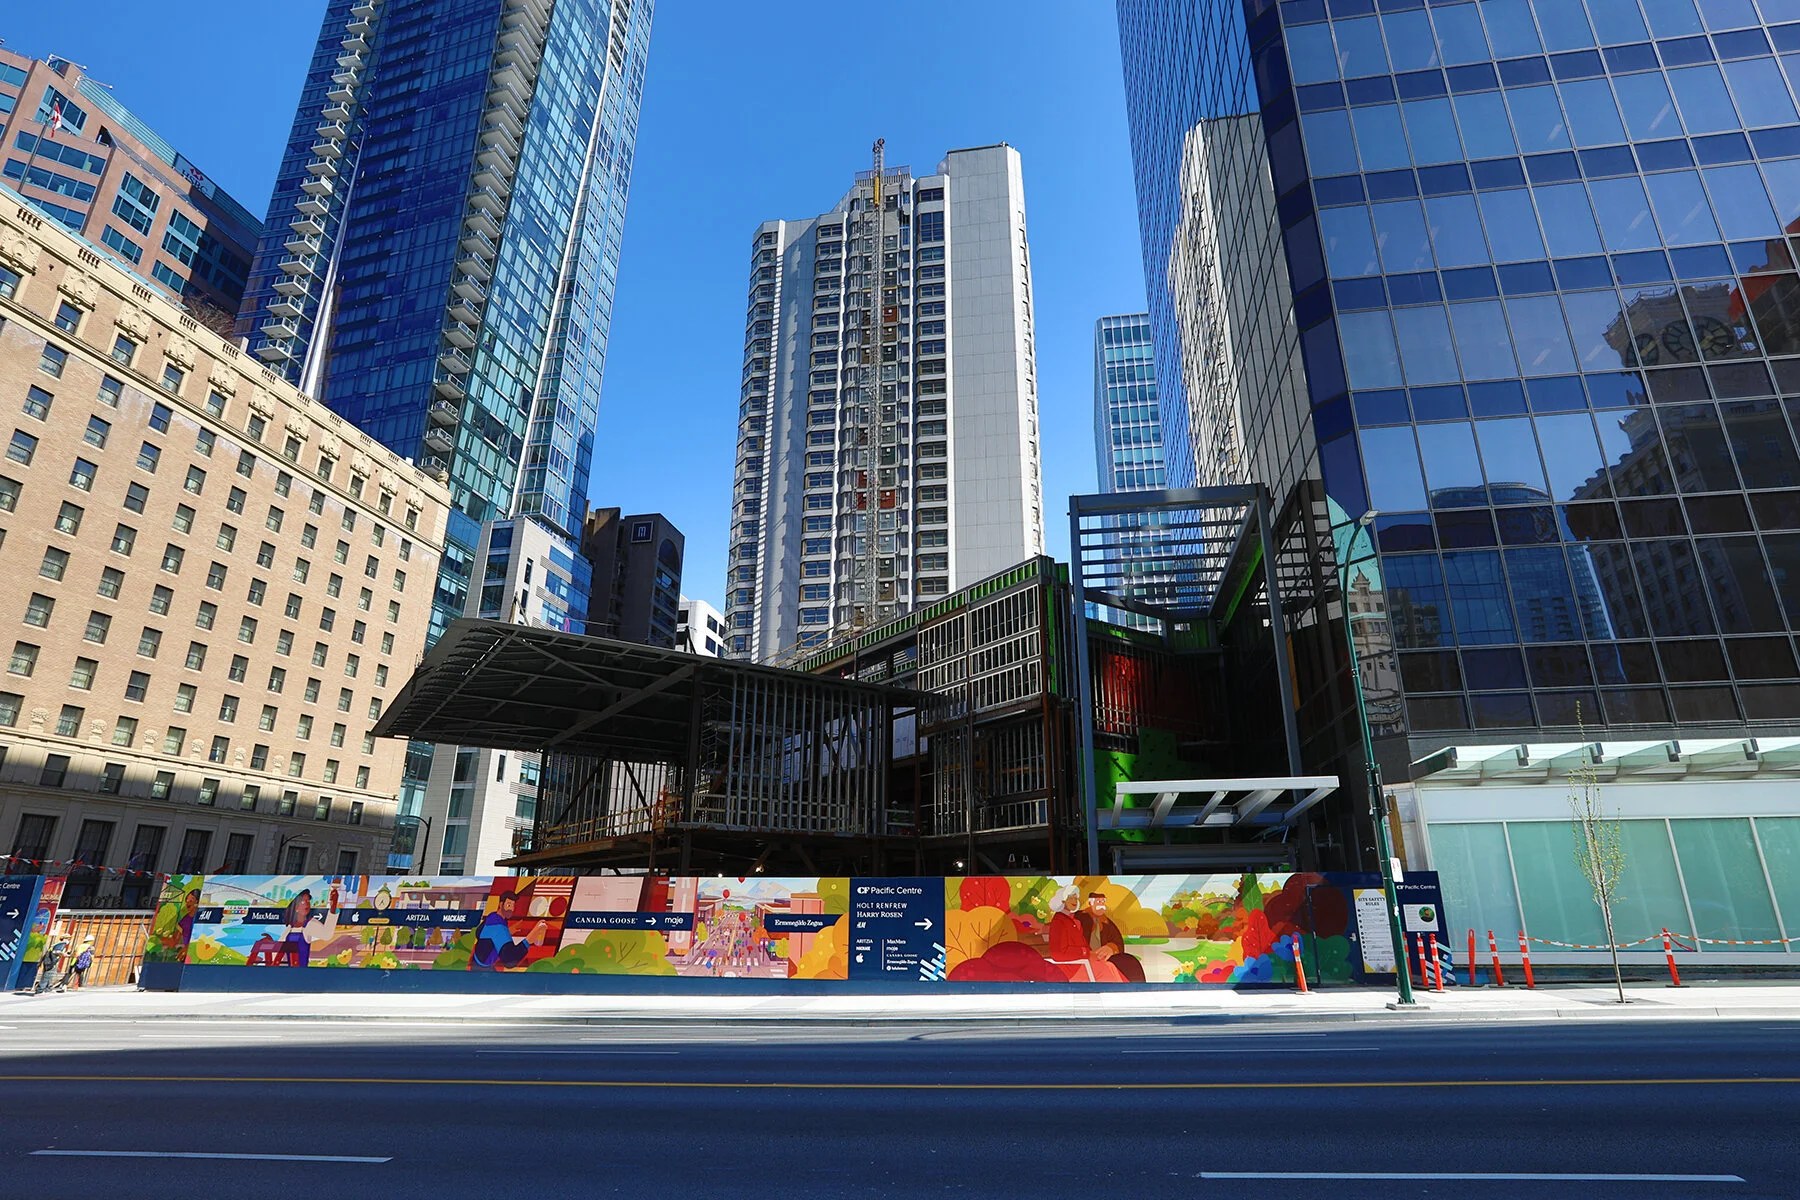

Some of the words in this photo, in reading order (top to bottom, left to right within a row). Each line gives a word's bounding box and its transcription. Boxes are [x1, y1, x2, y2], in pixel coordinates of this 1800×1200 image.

[182, 169, 208, 193] HSBC
[870, 886, 895, 894] Pacific
[896, 886, 922, 894] Centre
[406, 914, 430, 922] ARITZIA
[442, 914, 466, 922] MACKAGE
[575, 916, 607, 924] CANADA
[664, 916, 684, 926] maje
[806, 919, 823, 927] Zegna
